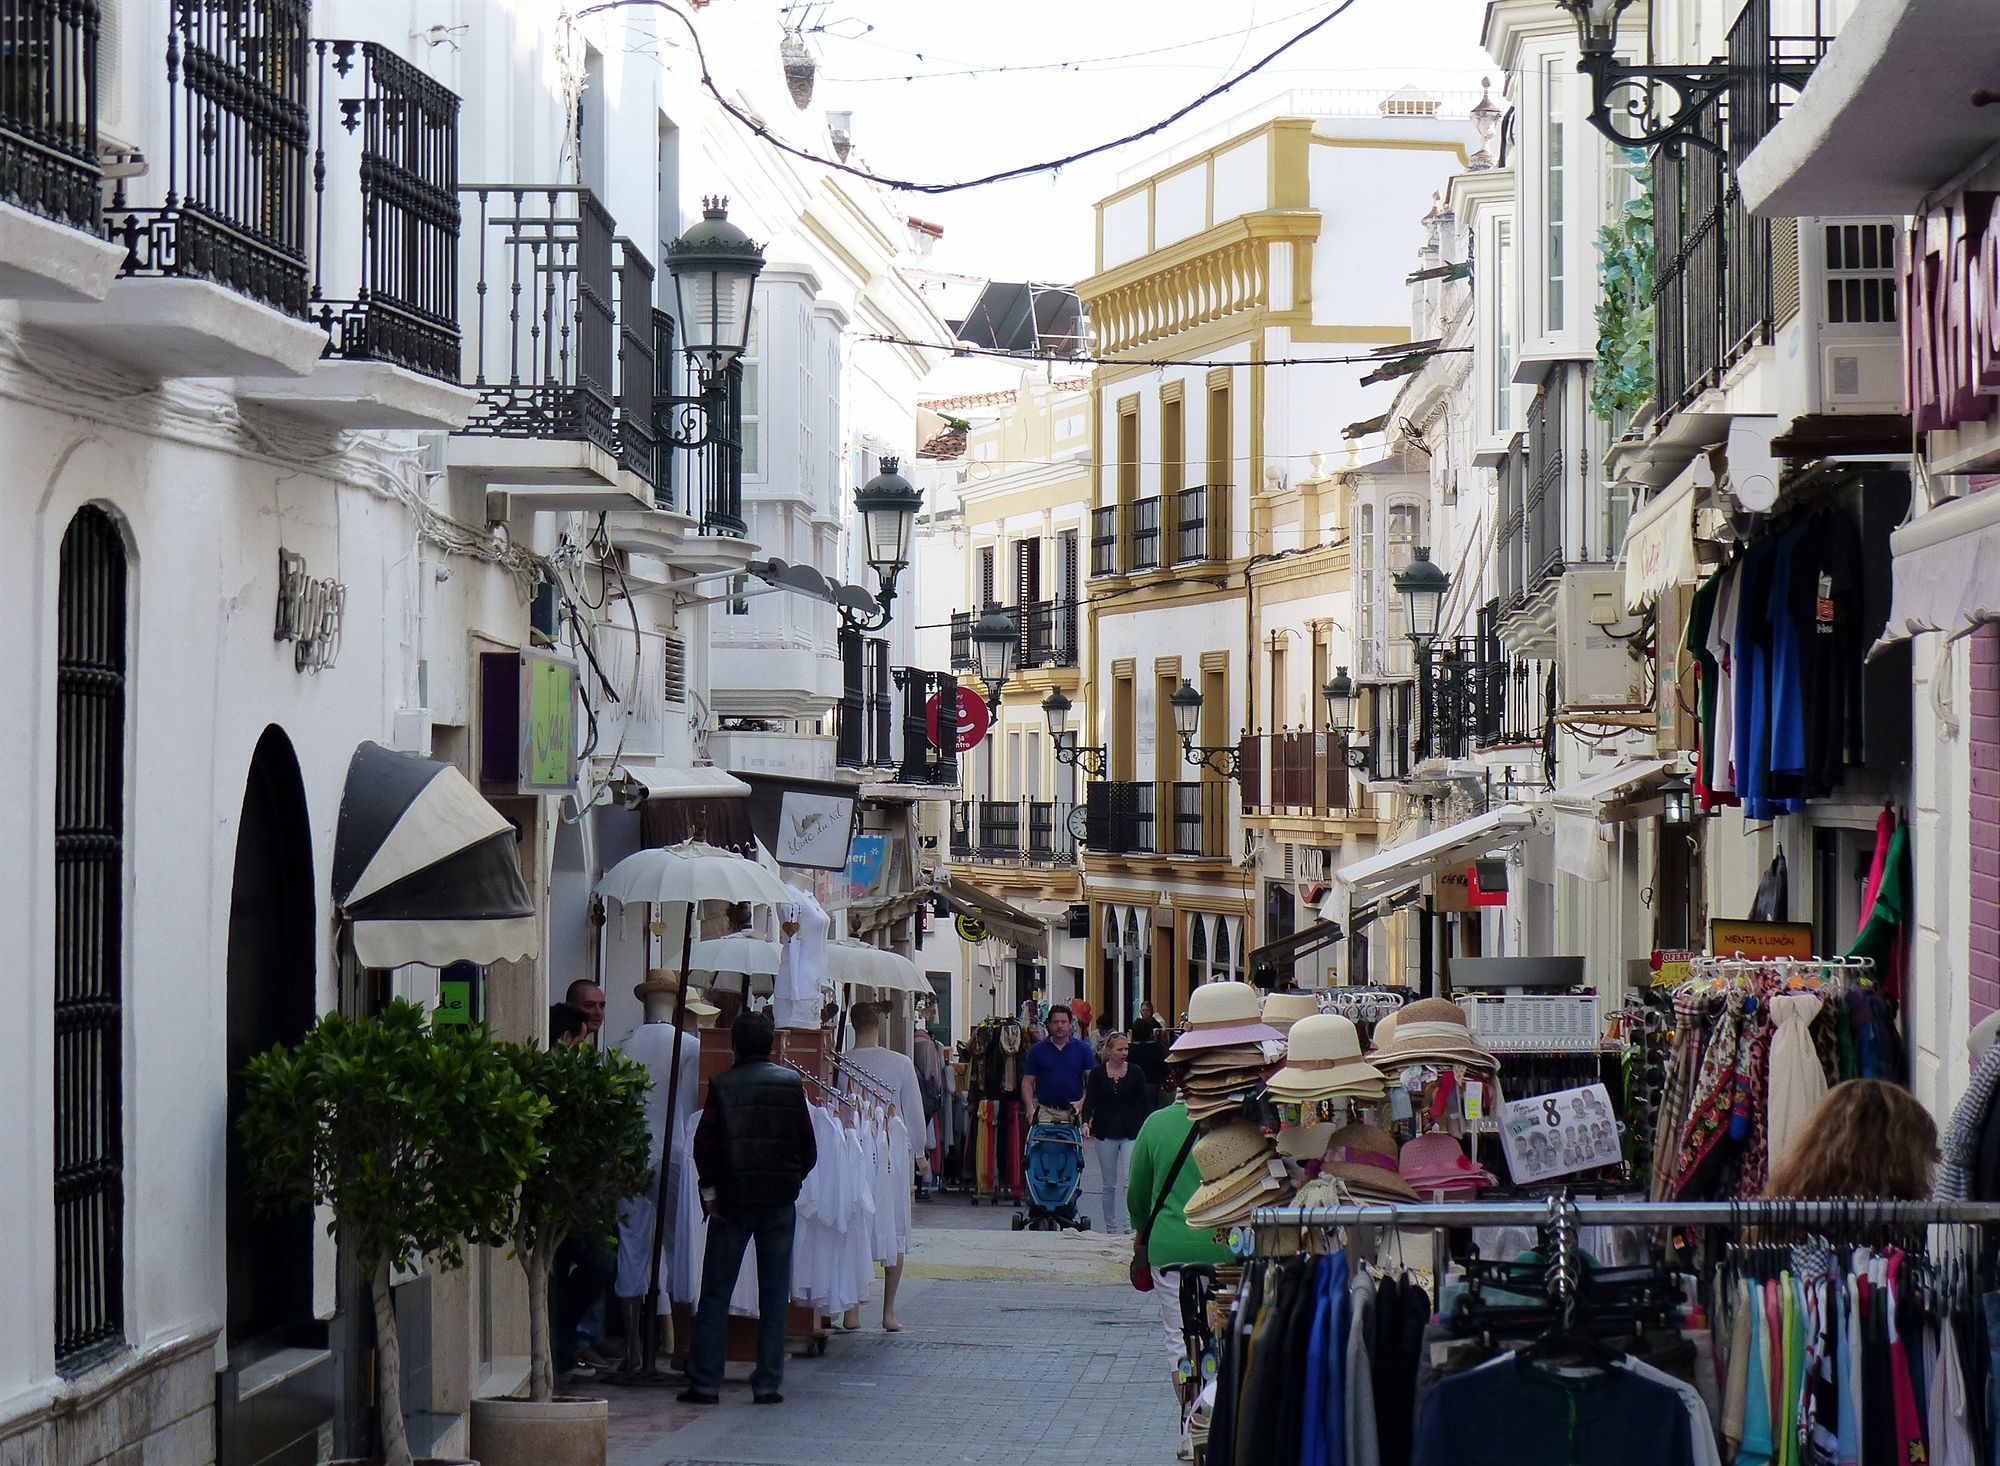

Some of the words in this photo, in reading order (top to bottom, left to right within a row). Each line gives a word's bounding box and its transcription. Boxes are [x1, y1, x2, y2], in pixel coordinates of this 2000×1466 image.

[816, 821, 829, 835] du
[1725, 935, 1756, 945] MENTA
[1765, 934, 1795, 946] LIMÓN
[1663, 952, 1694, 961] OFERTA
[1543, 1098, 1561, 1127] 8
